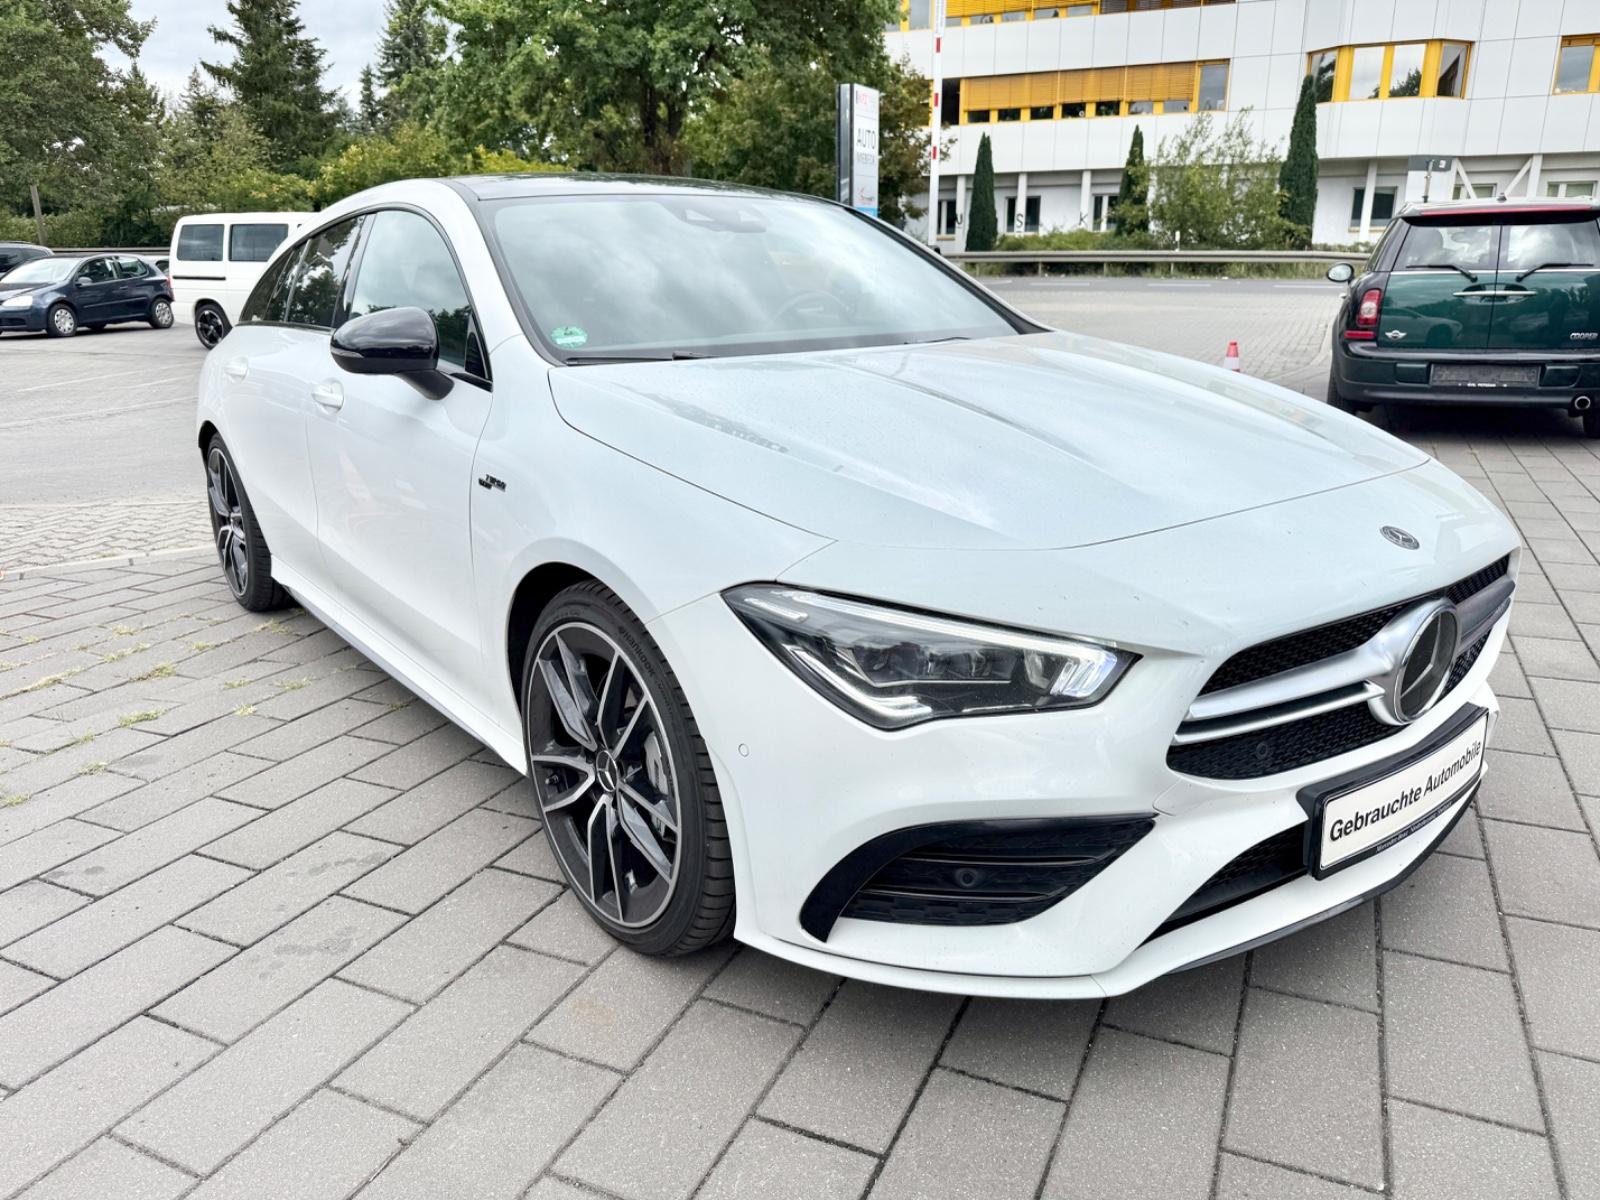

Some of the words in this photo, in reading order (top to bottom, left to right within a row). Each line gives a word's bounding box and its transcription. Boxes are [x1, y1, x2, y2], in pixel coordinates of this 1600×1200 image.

[856, 128, 877, 150] AUTO
[1016, 213, 1024, 228] S
[1078, 211, 1088, 228] K
[1330, 786, 1422, 842] Gebrauchte
[1423, 740, 1481, 797] Automobile
